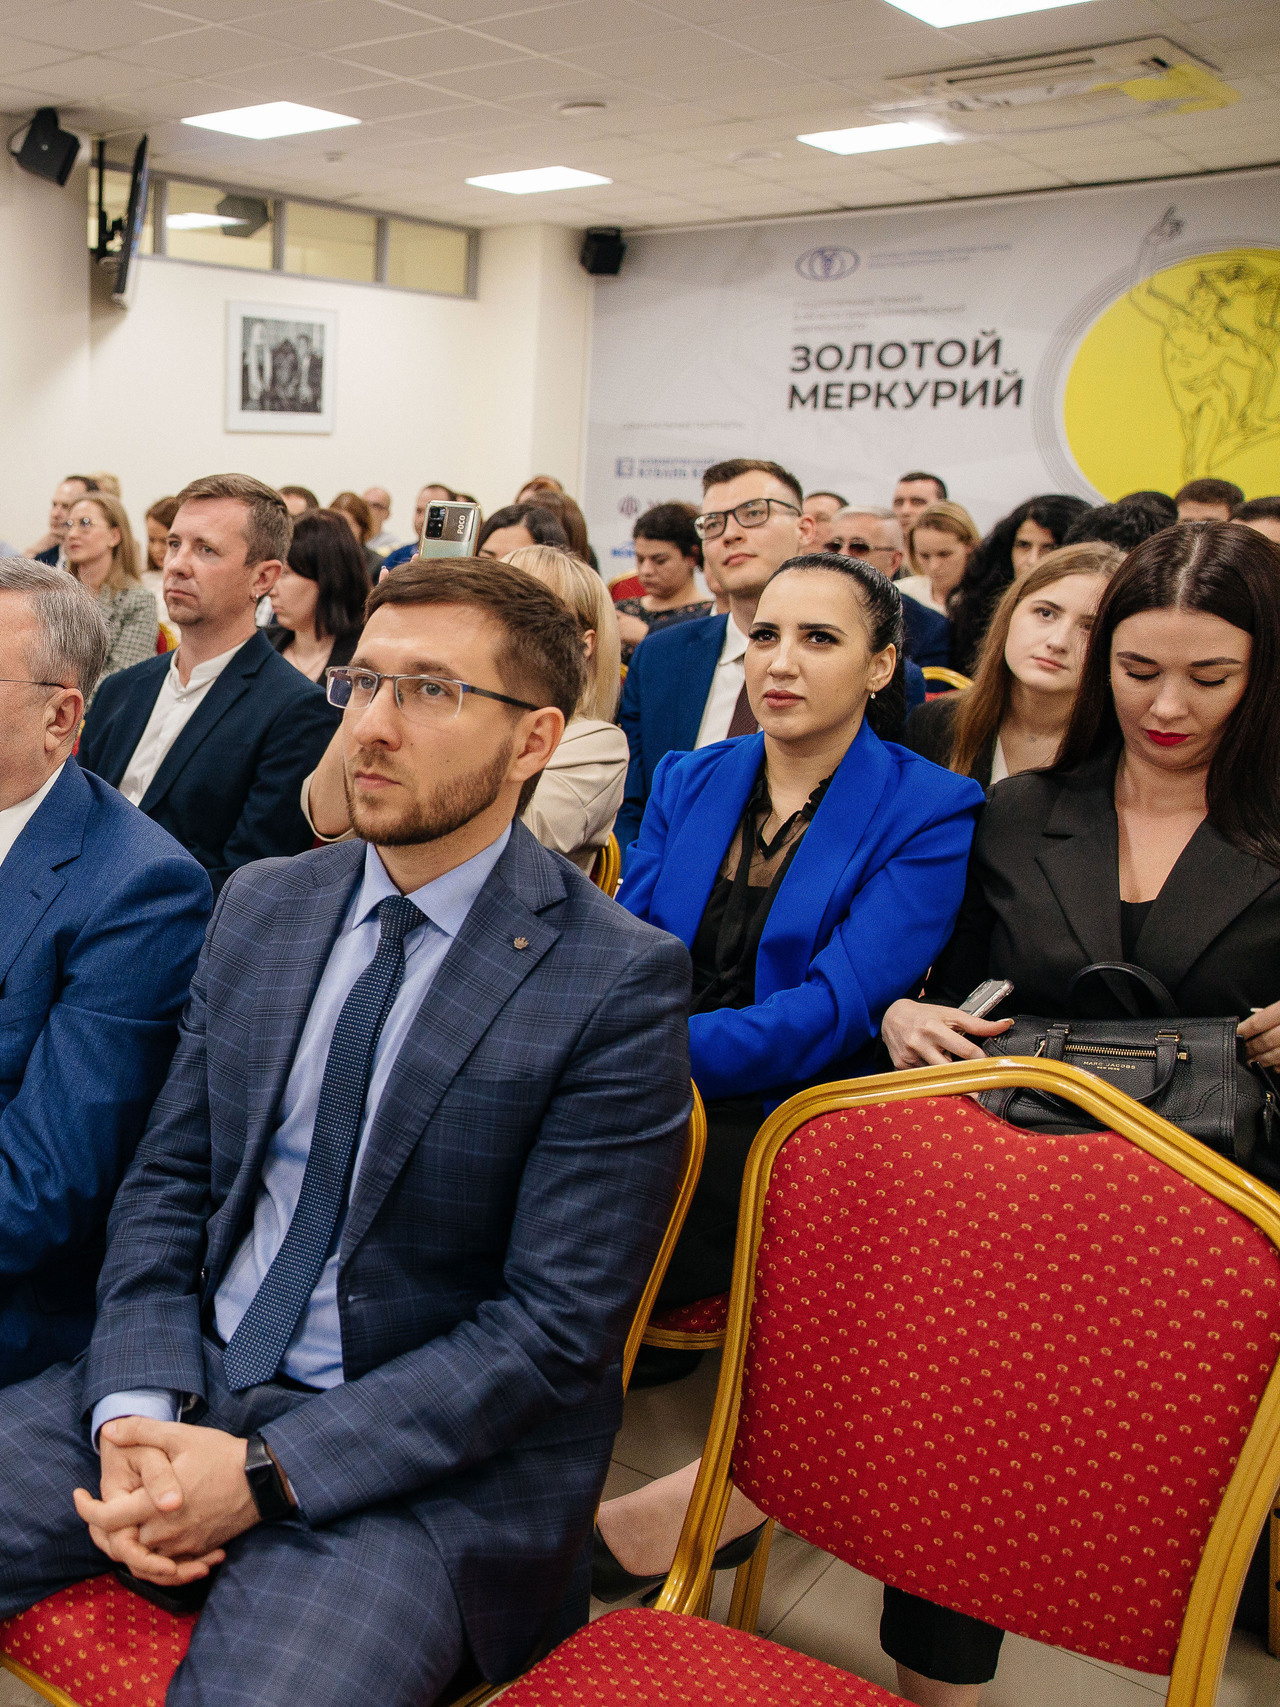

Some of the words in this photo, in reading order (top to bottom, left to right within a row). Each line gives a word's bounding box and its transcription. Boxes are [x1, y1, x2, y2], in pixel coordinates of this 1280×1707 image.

[790, 329, 1002, 372] ЗОЛОТОЙ
[788, 368, 1024, 409] МЕРКУРИЙ
[456, 514, 466, 535] POCO
